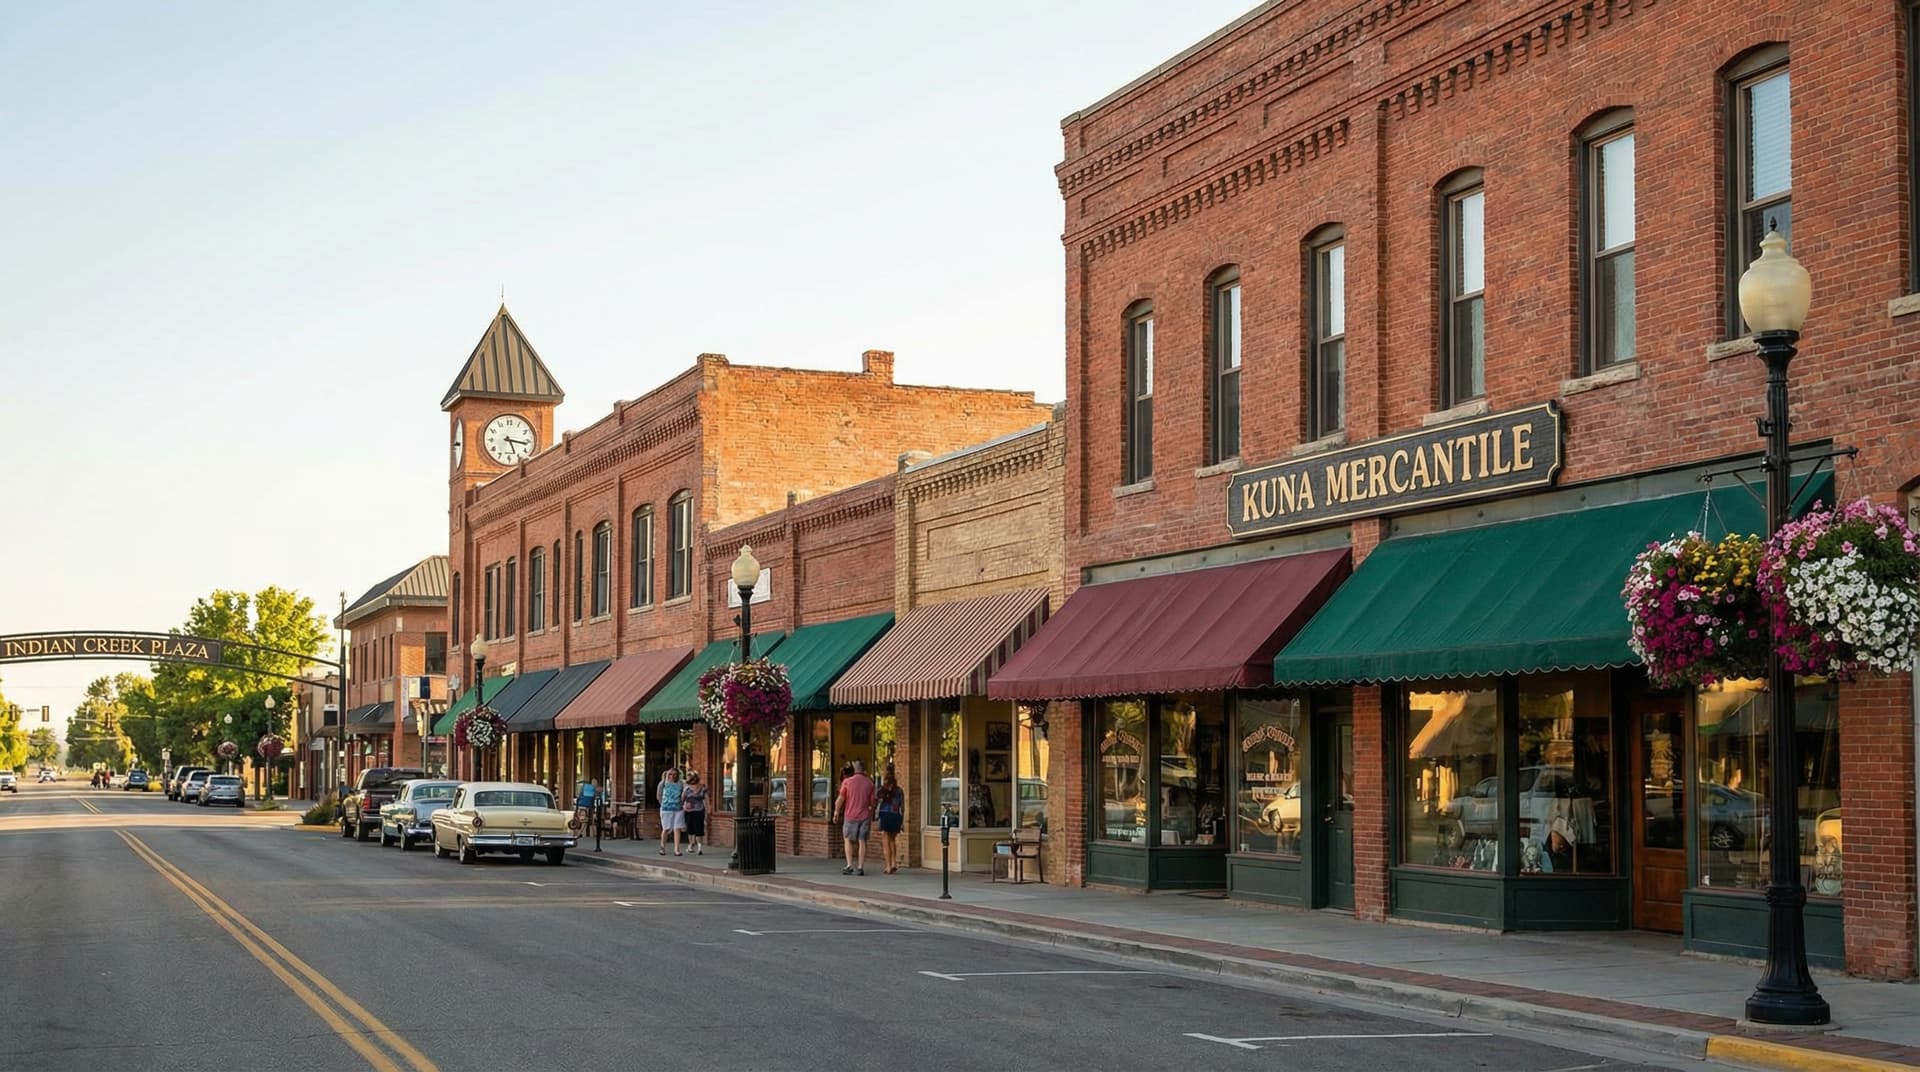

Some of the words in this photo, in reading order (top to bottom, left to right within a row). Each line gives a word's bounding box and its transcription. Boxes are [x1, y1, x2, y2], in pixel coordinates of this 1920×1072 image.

[1241, 470, 1316, 522] KUNA
[1325, 423, 1535, 506] MERCANTILE
[5, 638, 76, 657] INDIAN
[83, 637, 145, 655] CREEK
[151, 639, 209, 659] PLAZA
